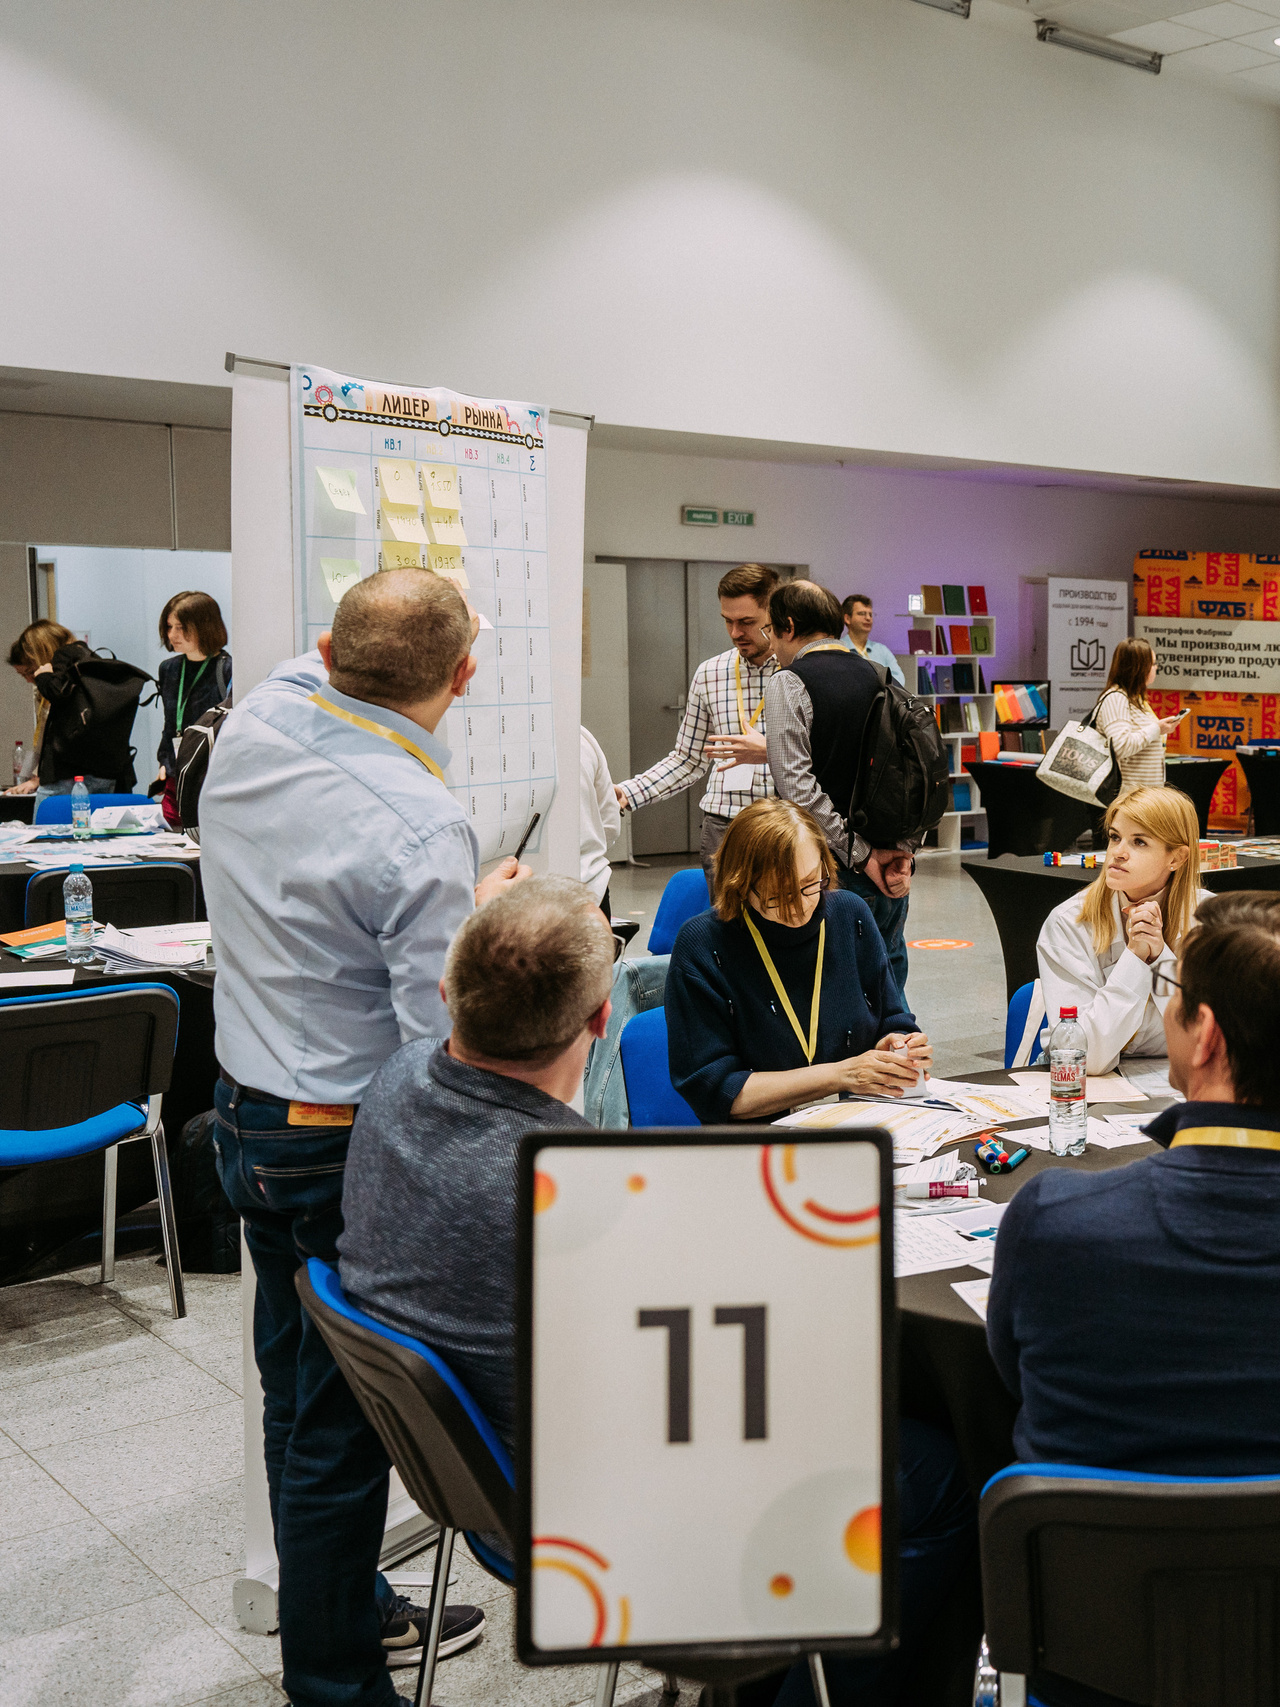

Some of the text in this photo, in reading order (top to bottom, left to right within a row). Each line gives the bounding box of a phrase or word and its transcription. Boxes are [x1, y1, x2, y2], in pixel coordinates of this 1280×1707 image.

[383, 394, 503, 430] ЛИДЕР РЫНКА
[384, 438, 401, 450] КВ.1
[465, 448, 479, 460] КВ.3
[727, 512, 749, 525] EXIT
[1059, 589, 1117, 601] ПРОИЗВОДСТВО
[1197, 601, 1247, 617] ФАБ
[1075, 617, 1094, 626] 1994
[1143, 626, 1232, 637] Типография Фабрика
[1155, 637, 1177, 648] Мы
[1181, 640, 1261, 651] производим
[1155, 654, 1235, 666] сувенирную
[1183, 668, 1261, 680] материалы.
[1197, 716, 1245, 732] ФАБ
[1060, 746, 1099, 769] TOUS
[637, 1304, 768, 1445] 11
